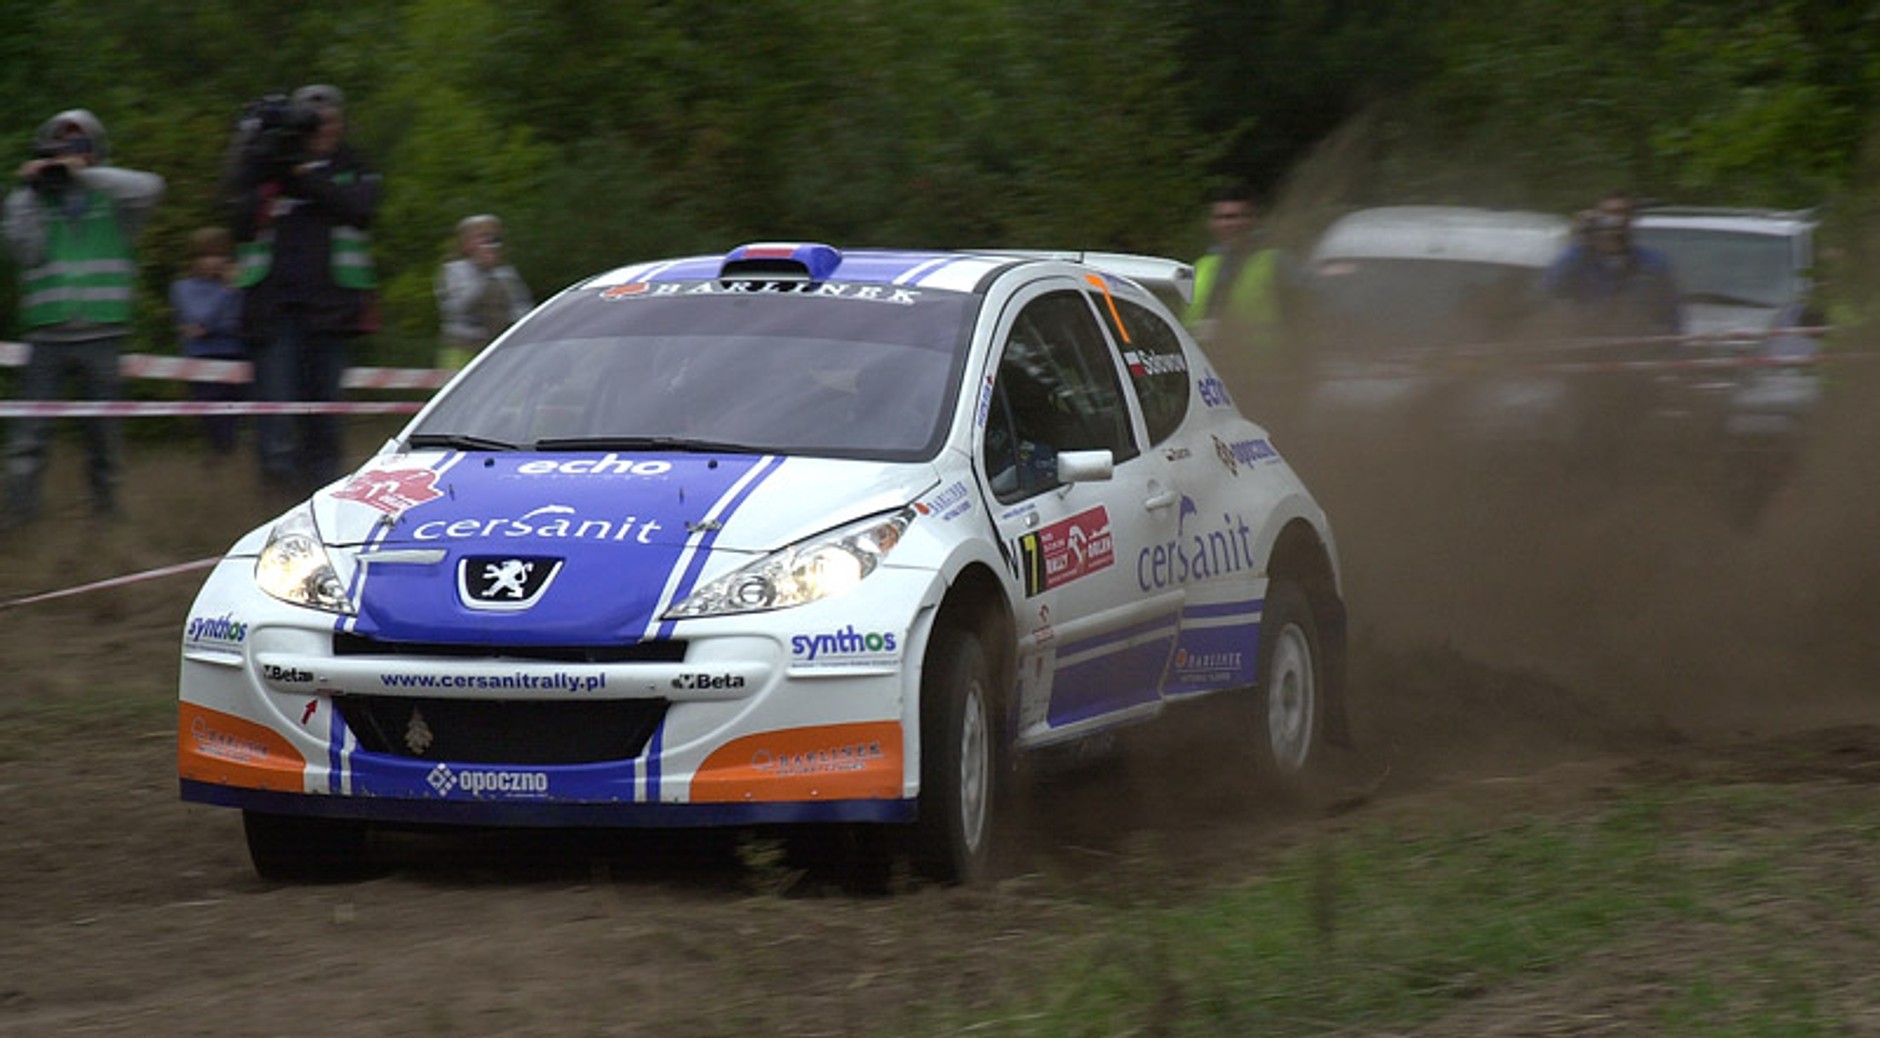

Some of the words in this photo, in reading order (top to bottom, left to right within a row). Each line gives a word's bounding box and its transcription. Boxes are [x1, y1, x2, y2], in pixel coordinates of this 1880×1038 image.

[651, 280, 923, 305] BARLINEK
[1084, 274, 1132, 344] 7
[516, 453, 673, 475] echo
[412, 506, 662, 544] cersanit
[1137, 500, 1254, 592] cersanit
[1023, 533, 1039, 598] 7
[188, 612, 248, 642] synthos
[791, 624, 897, 661] synthos
[380, 672, 607, 693] www.cersanitrally.pl
[696, 673, 745, 690] Beta
[459, 770, 548, 796] opoczno
